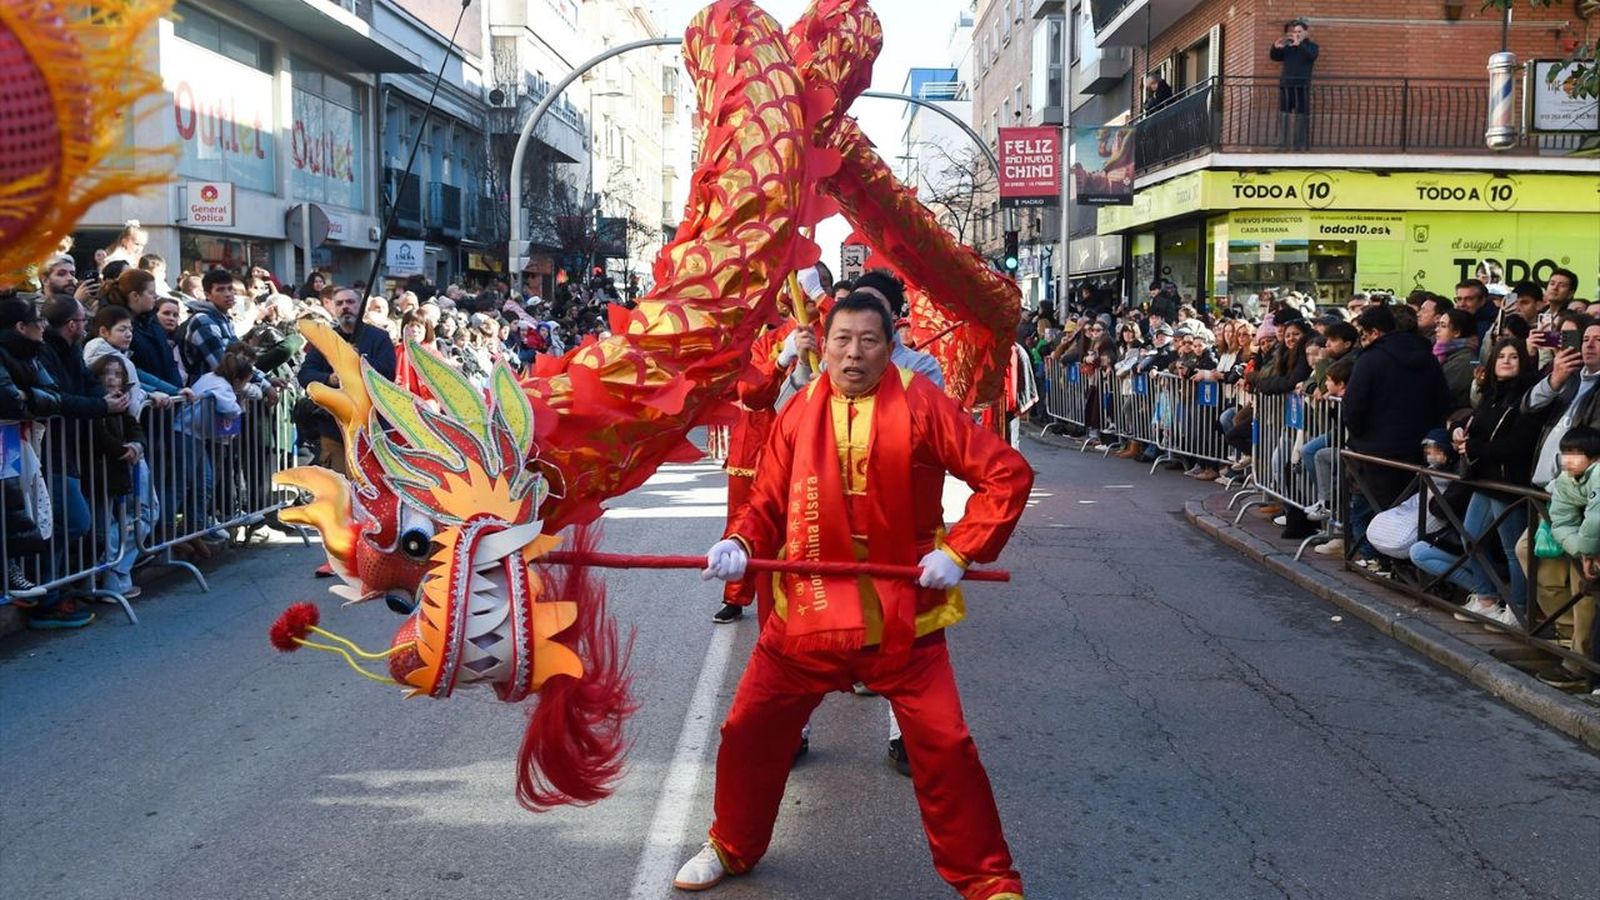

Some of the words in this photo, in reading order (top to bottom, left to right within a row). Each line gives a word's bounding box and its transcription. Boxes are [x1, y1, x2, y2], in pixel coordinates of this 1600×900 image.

[1004, 139, 1053, 154] FELIZ
[1004, 154, 1023, 164] AÑO
[1024, 155, 1054, 164] NUEVO
[1005, 164, 1054, 179] CHINO
[1232, 185, 1283, 198] TODO
[1285, 185, 1297, 198] A
[1307, 182, 1331, 200] 10
[1416, 187, 1466, 200] TODO
[1468, 188, 1480, 200] A
[1491, 185, 1513, 201] 10
[191, 204, 227, 213] General
[194, 213, 224, 222] Optica
[1319, 224, 1384, 235] todoa10.es
[1451, 238, 1461, 249] el
[1463, 238, 1504, 253] original
[804, 475, 820, 522] Usera
[804, 524, 820, 562] hina
